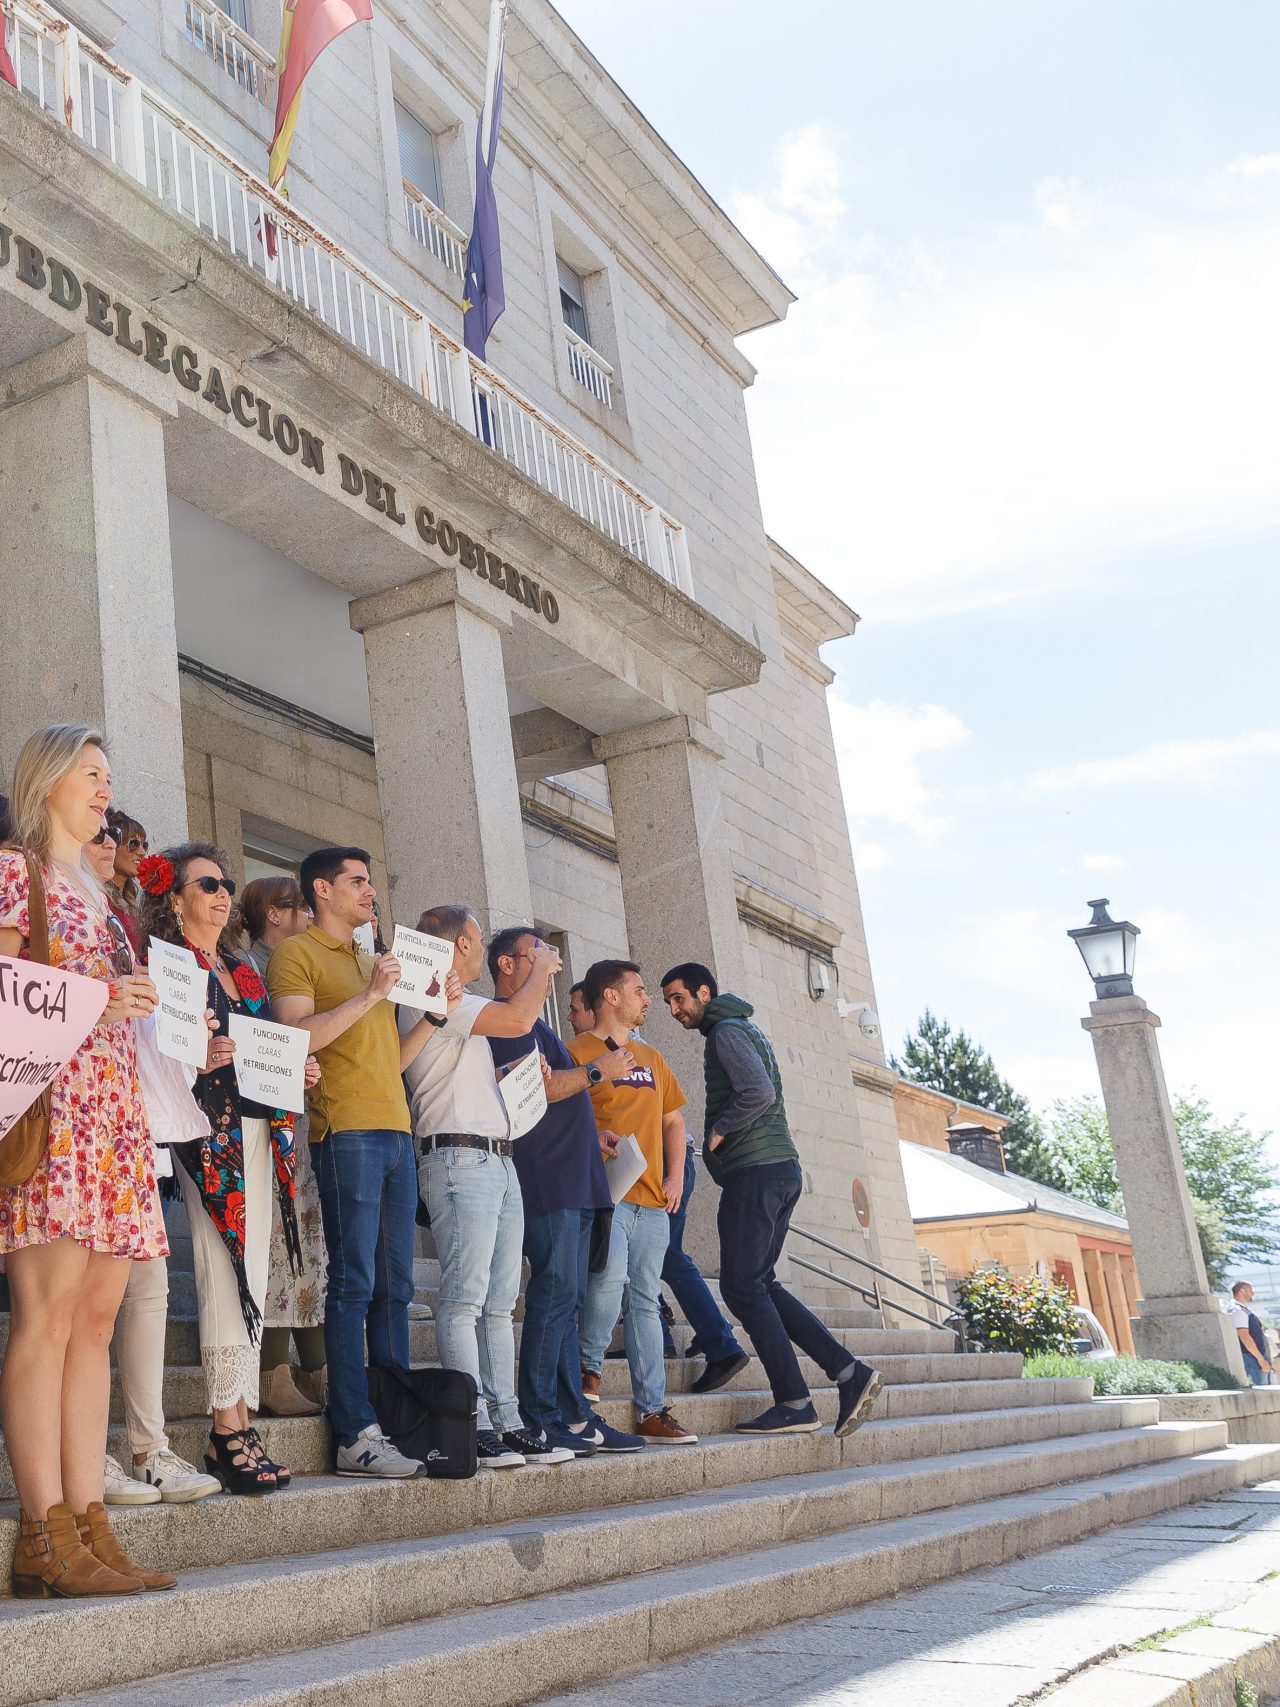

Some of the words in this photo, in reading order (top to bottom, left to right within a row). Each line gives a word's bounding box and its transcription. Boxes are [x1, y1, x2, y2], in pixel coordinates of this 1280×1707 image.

[337, 453, 405, 525] DEL
[415, 506, 560, 624] GOBIERNO
[397, 932, 422, 946] JUSTICIA
[427, 941, 450, 955] HUELGA
[396, 950, 404, 958] LA
[405, 952, 433, 968] MINISTRA
[163, 966, 191, 986] FUNCIONES
[168, 987, 186, 1003] CLARAS
[161, 1003, 198, 1025] RETRIBUCIONES
[171, 1033, 189, 1047] JUSTAS
[253, 1028, 290, 1044] FUNCIONES
[258, 1046, 282, 1059] CLARAS
[243, 1058, 292, 1077] RETRIBUCIONES
[259, 1083, 279, 1095] JUSTAS
